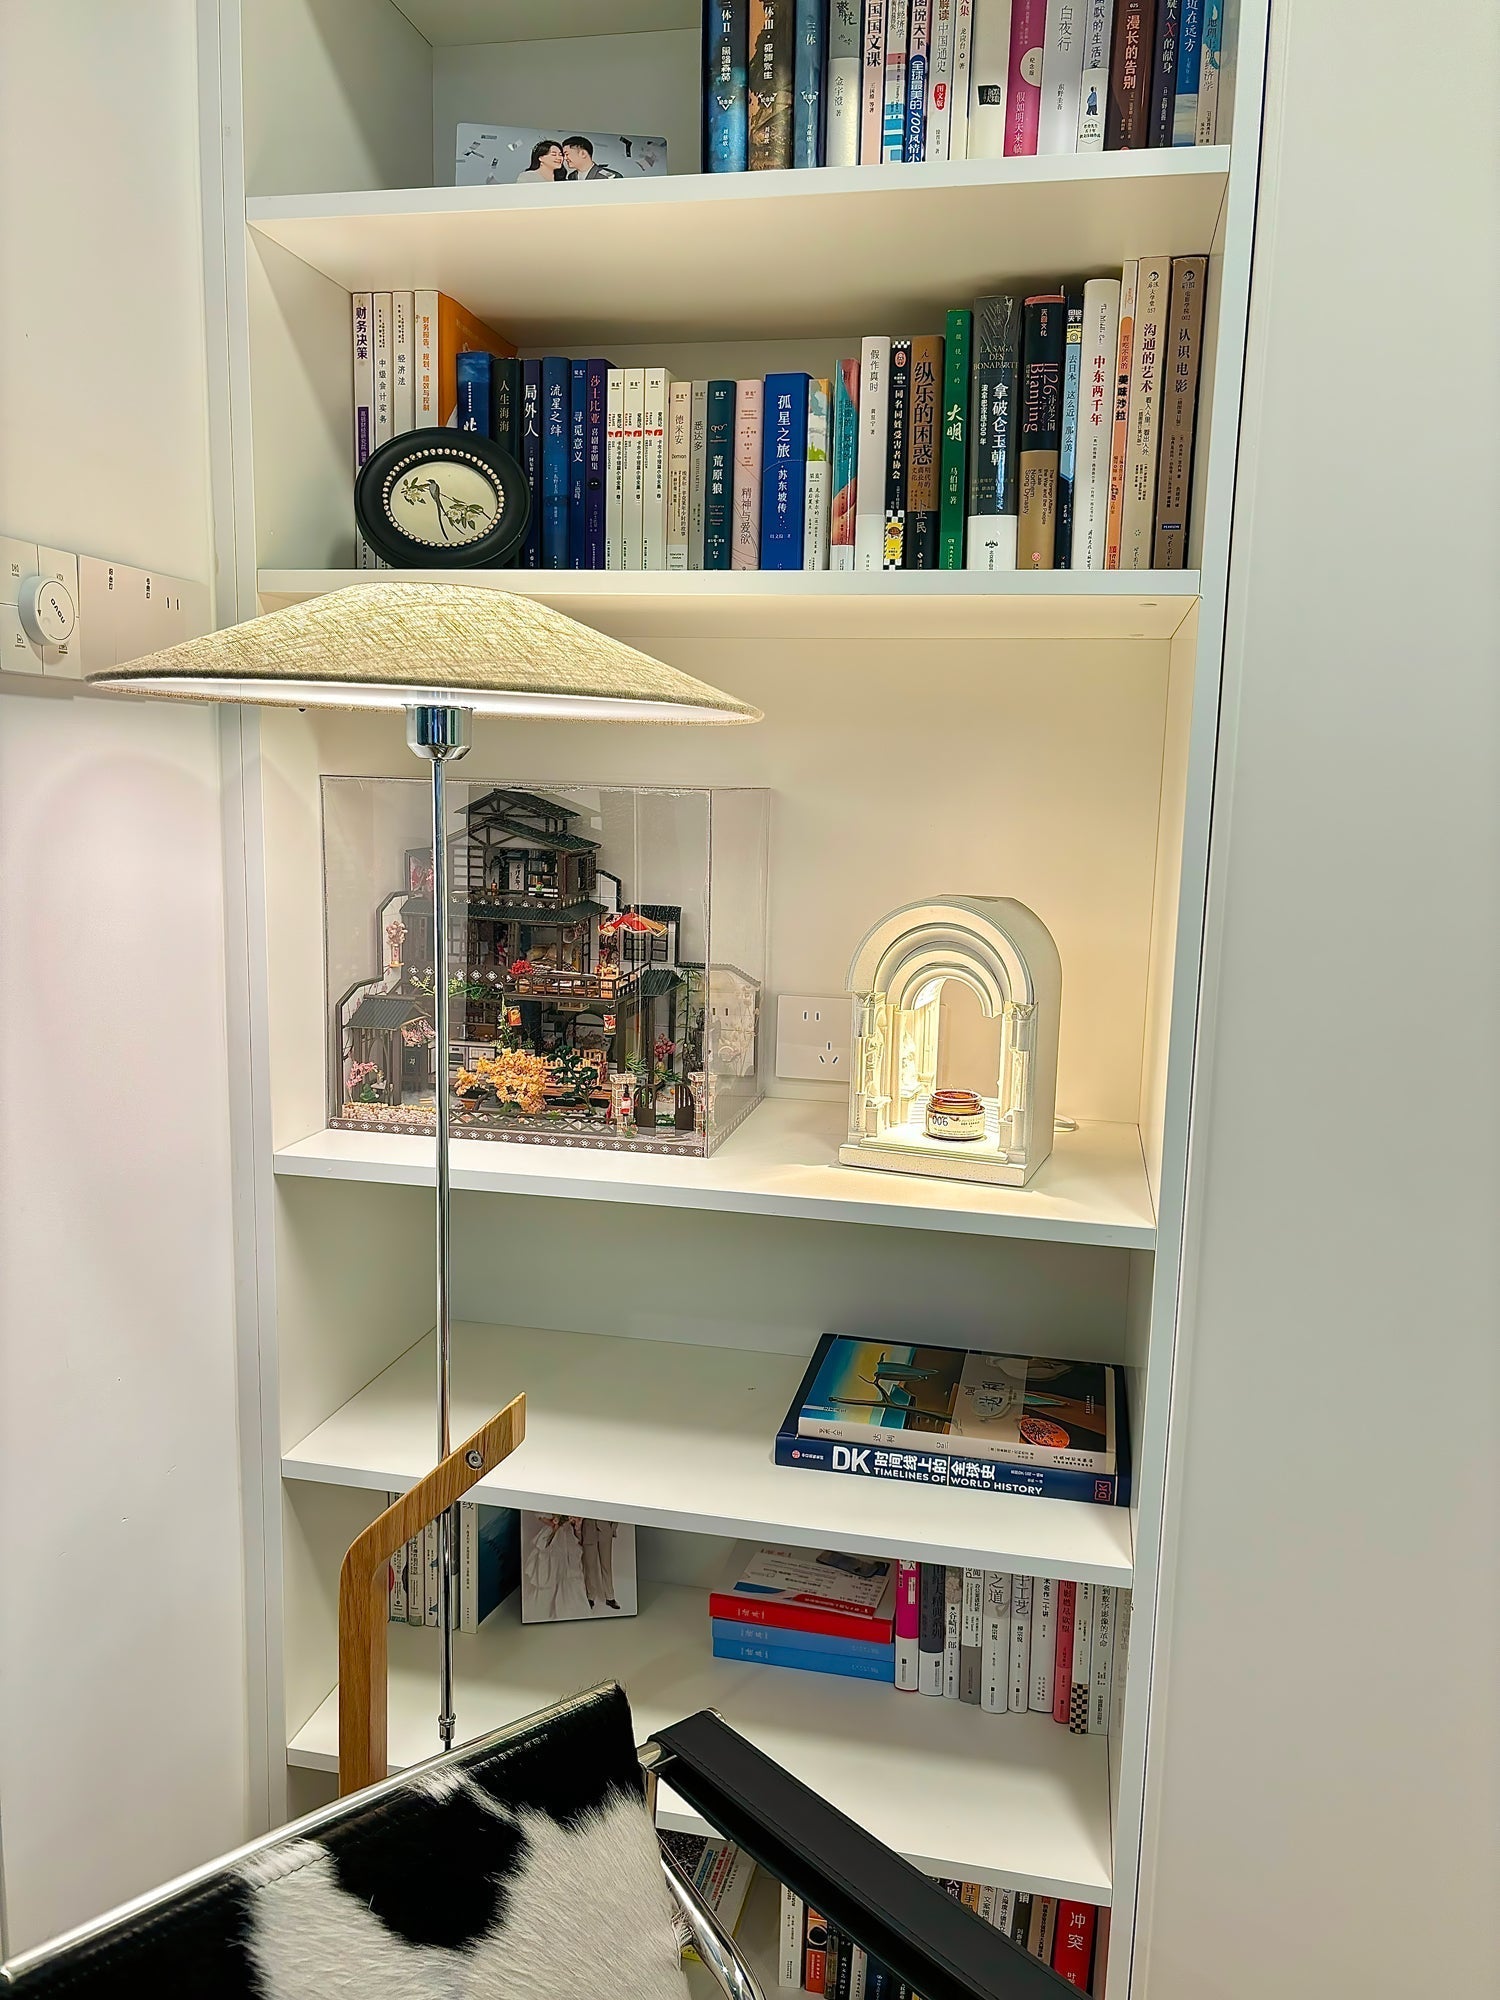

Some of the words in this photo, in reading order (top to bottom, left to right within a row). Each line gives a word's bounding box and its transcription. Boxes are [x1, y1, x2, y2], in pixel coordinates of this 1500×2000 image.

[806, 22, 816, 46] 三体
[1057, 5, 1073, 52] 白夜行
[1122, 15, 1141, 90] 漫长的告别
[1202, 18, 1217, 90] 地理上的经济学
[1012, 91, 1026, 154] 假如明天来临
[355, 307, 369, 360] 财务决策
[1140, 323, 1157, 393] 沟通的艺术
[397, 354, 407, 386] 经济法
[1175, 328, 1192, 393] 认识电影
[378, 358, 388, 424] 中级会计实务
[499, 380, 510, 432] 人生海海
[524, 384, 539, 437] 局外人
[549, 384, 562, 437] 流星之绊
[913, 361, 936, 465] 纵乐的困惑
[1023, 363, 1044, 432] Bianjing
[1089, 355, 1106, 426] 中东两千年
[1115, 374, 1129, 421] 美味沙拉
[463, 417, 478, 432] 北
[572, 411, 584, 463] 寻觅意义
[675, 414, 684, 445] 德米安
[693, 420, 703, 452] 悉达多
[776, 394, 792, 458] 孤星之旅
[892, 389, 904, 480] 同名同姓受害者协会
[946, 404, 964, 441] 大明
[990, 382, 1009, 466] 拿破仑王朝
[711, 454, 724, 495] 荒原狼
[777, 469, 788, 514] 苏东坡传
[949, 467, 958, 492] 马伯庸
[740, 487, 753, 545] 精神与爱欲
[1022, 488, 1030, 515] Dynasty
[832, 1445, 871, 1474] DK
[873, 1466, 929, 1481] TIMELINES
[931, 1473, 947, 1484] OF
[950, 1475, 992, 1490] WORLD
[993, 1481, 1043, 1496] HISTORY
[874, 1450, 948, 1476] 时间线上的
[950, 1459, 996, 1481] 全球史
[988, 1573, 1004, 1606] 之道
[1067, 1911, 1086, 1951] 冲突
